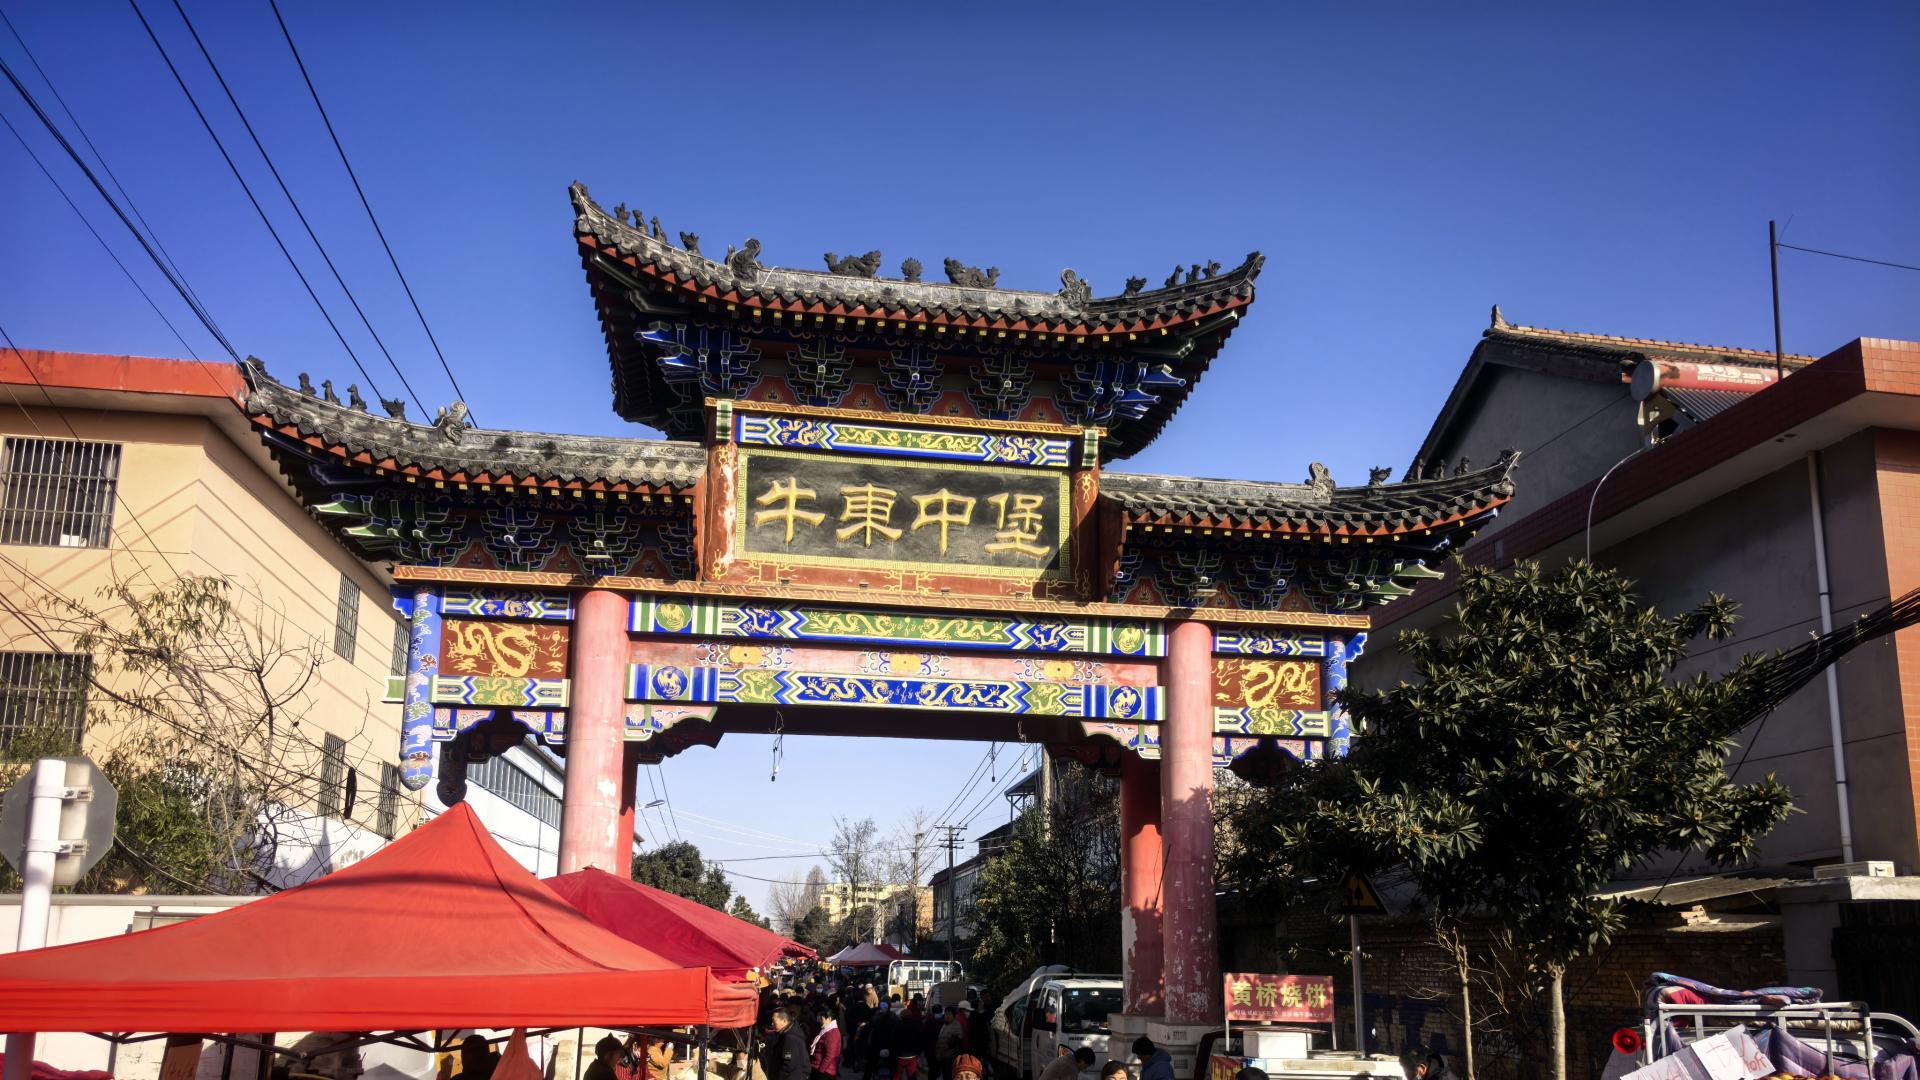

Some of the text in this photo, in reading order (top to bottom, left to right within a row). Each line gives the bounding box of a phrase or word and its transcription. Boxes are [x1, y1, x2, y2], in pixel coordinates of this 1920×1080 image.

[754, 477, 1050, 557] 牛東中堡
[1231, 980, 1326, 1009] 黄桥烧饼
